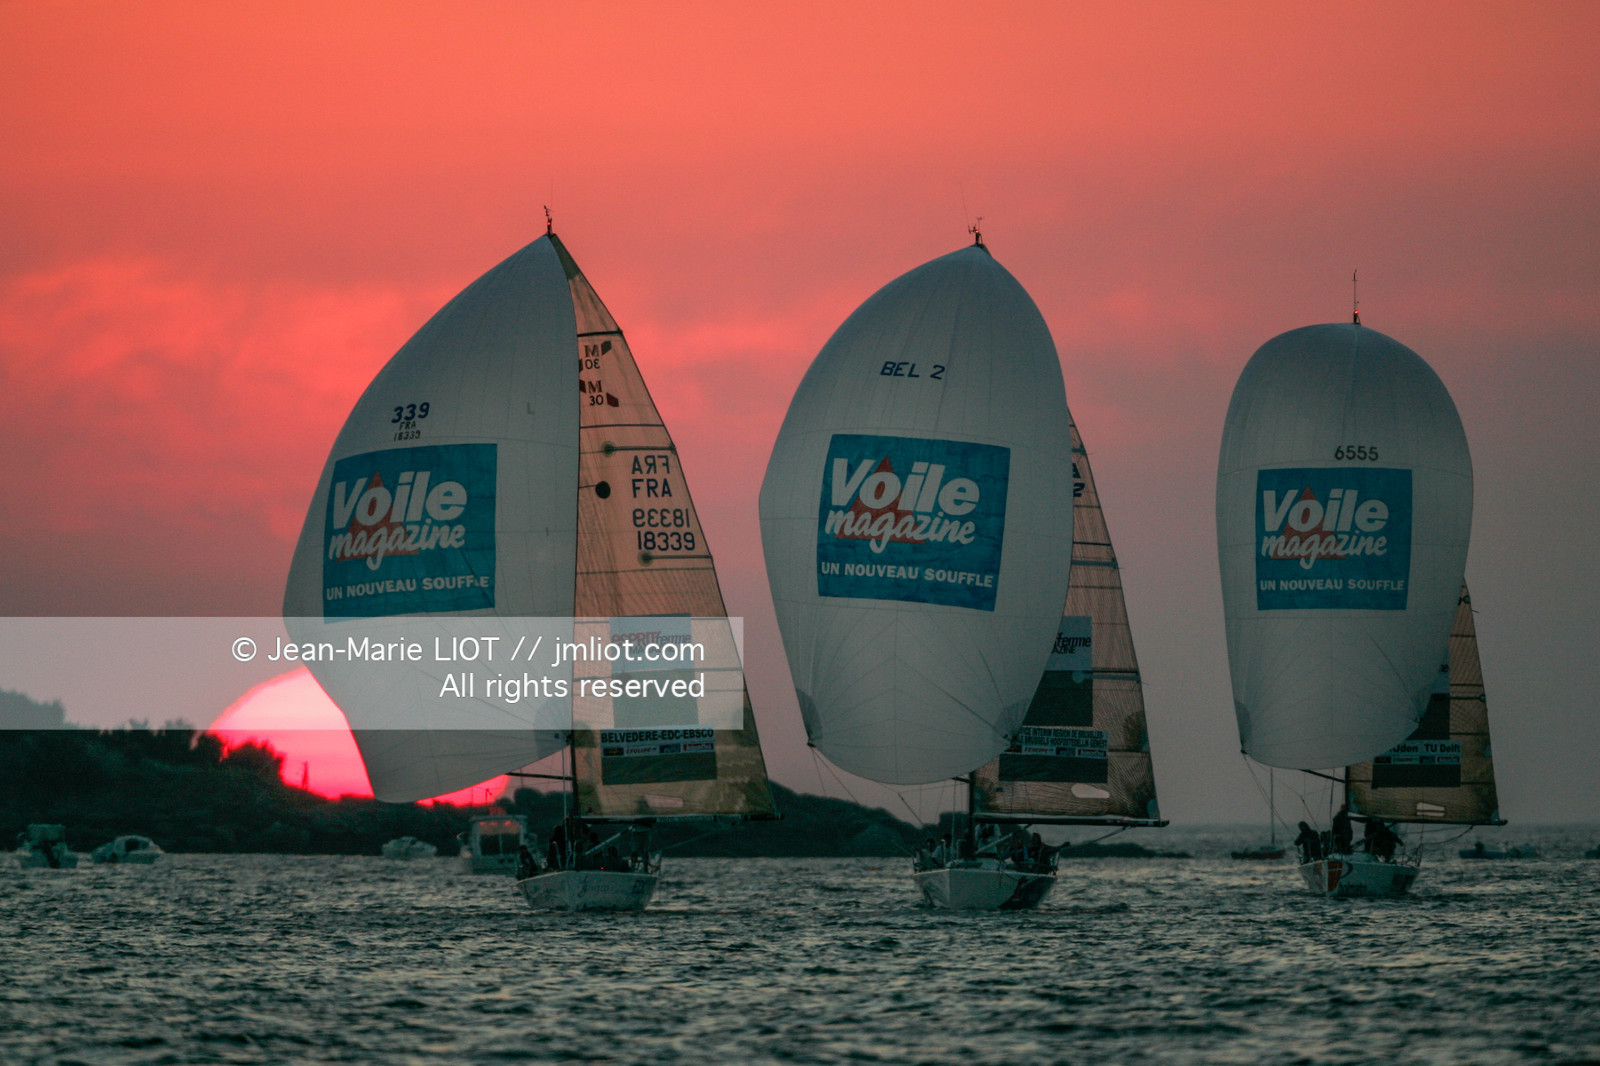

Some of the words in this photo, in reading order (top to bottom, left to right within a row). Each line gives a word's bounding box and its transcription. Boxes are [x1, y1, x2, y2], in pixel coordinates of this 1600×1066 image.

[880, 361, 920, 378] BEL
[930, 364, 946, 380] 2
[588, 380, 603, 394] M
[589, 394, 604, 406] 30
[391, 402, 430, 423] 339
[399, 420, 416, 431] FRA
[1334, 445, 1379, 461] 6555
[632, 478, 672, 498] FRA
[831, 457, 980, 516] Voile
[333, 471, 468, 530] Voile
[1263, 488, 1389, 532] Voile
[637, 531, 696, 550] 18339
[824, 509, 976, 553] magazine
[328, 518, 466, 571] magazine
[1261, 530, 1388, 570] magazine
[821, 561, 840, 575] UN
[844, 564, 919, 580] NOUVEAU
[924, 568, 994, 588] SOUFFLE
[326, 586, 343, 600] UN
[347, 578, 417, 597] NOUVEAU
[422, 574, 490, 590] SOUFFLE
[1260, 580, 1276, 591] UN
[1280, 579, 1343, 591] NOUVEAU
[1348, 579, 1405, 591] SOUFFLE
[601, 729, 714, 744] BELVEDERE-EDC-EBSCO
[1424, 744, 1437, 753] TU
[1440, 743, 1461, 753] Delft
